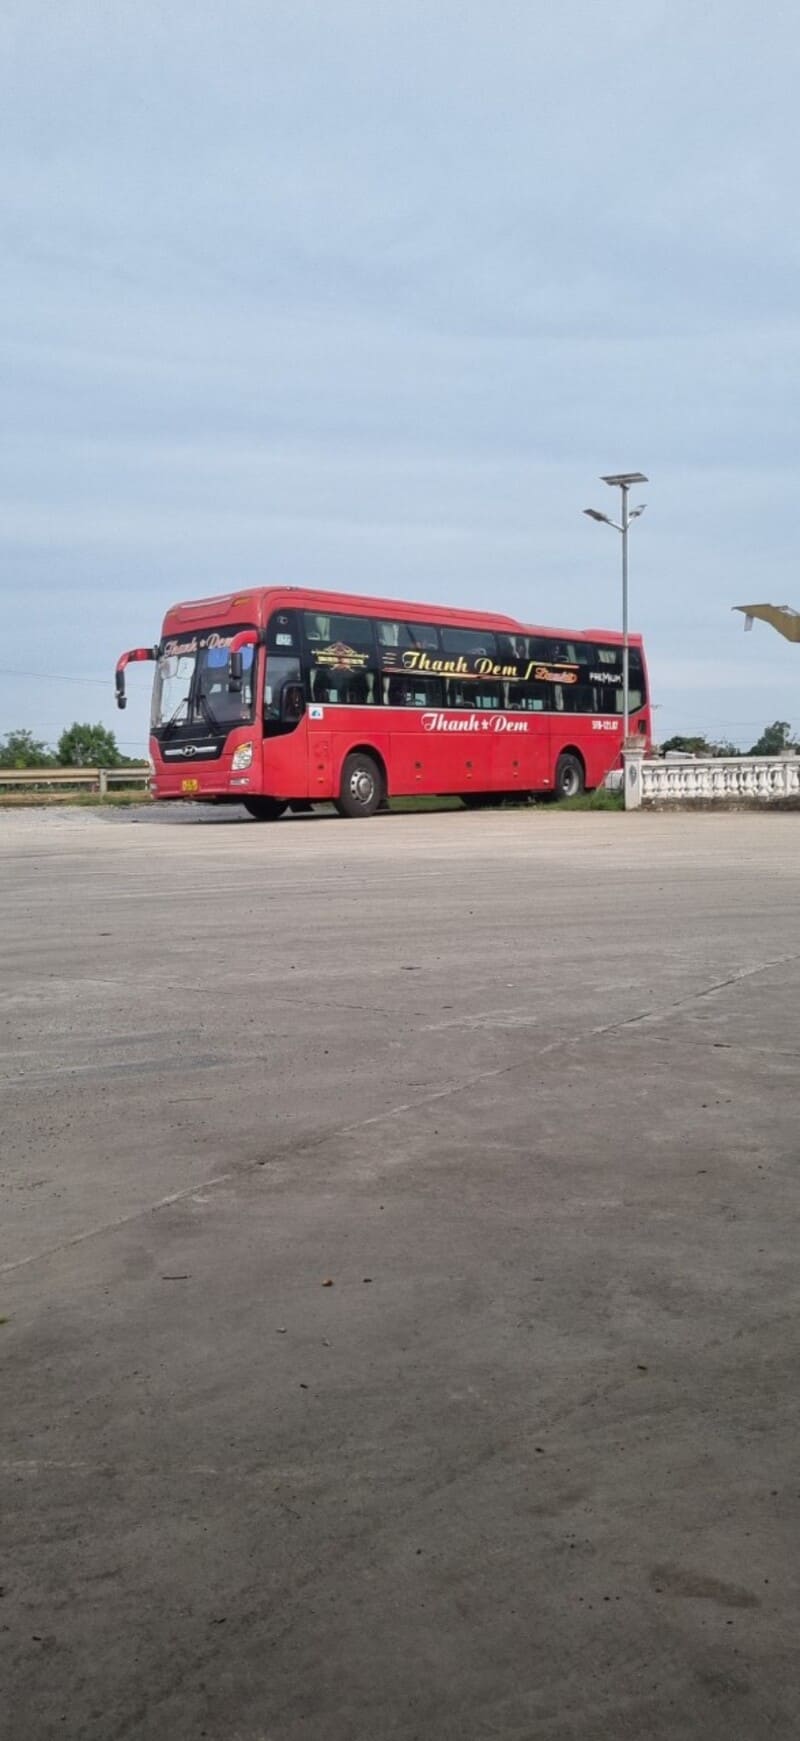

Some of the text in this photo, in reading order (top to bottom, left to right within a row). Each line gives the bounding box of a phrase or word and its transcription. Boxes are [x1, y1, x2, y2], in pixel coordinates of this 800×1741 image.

[164, 636, 198, 657] Thanh
[402, 651, 468, 673] Thanh
[474, 657, 517, 676] Dem
[421, 712, 528, 732] Thanh Dem
